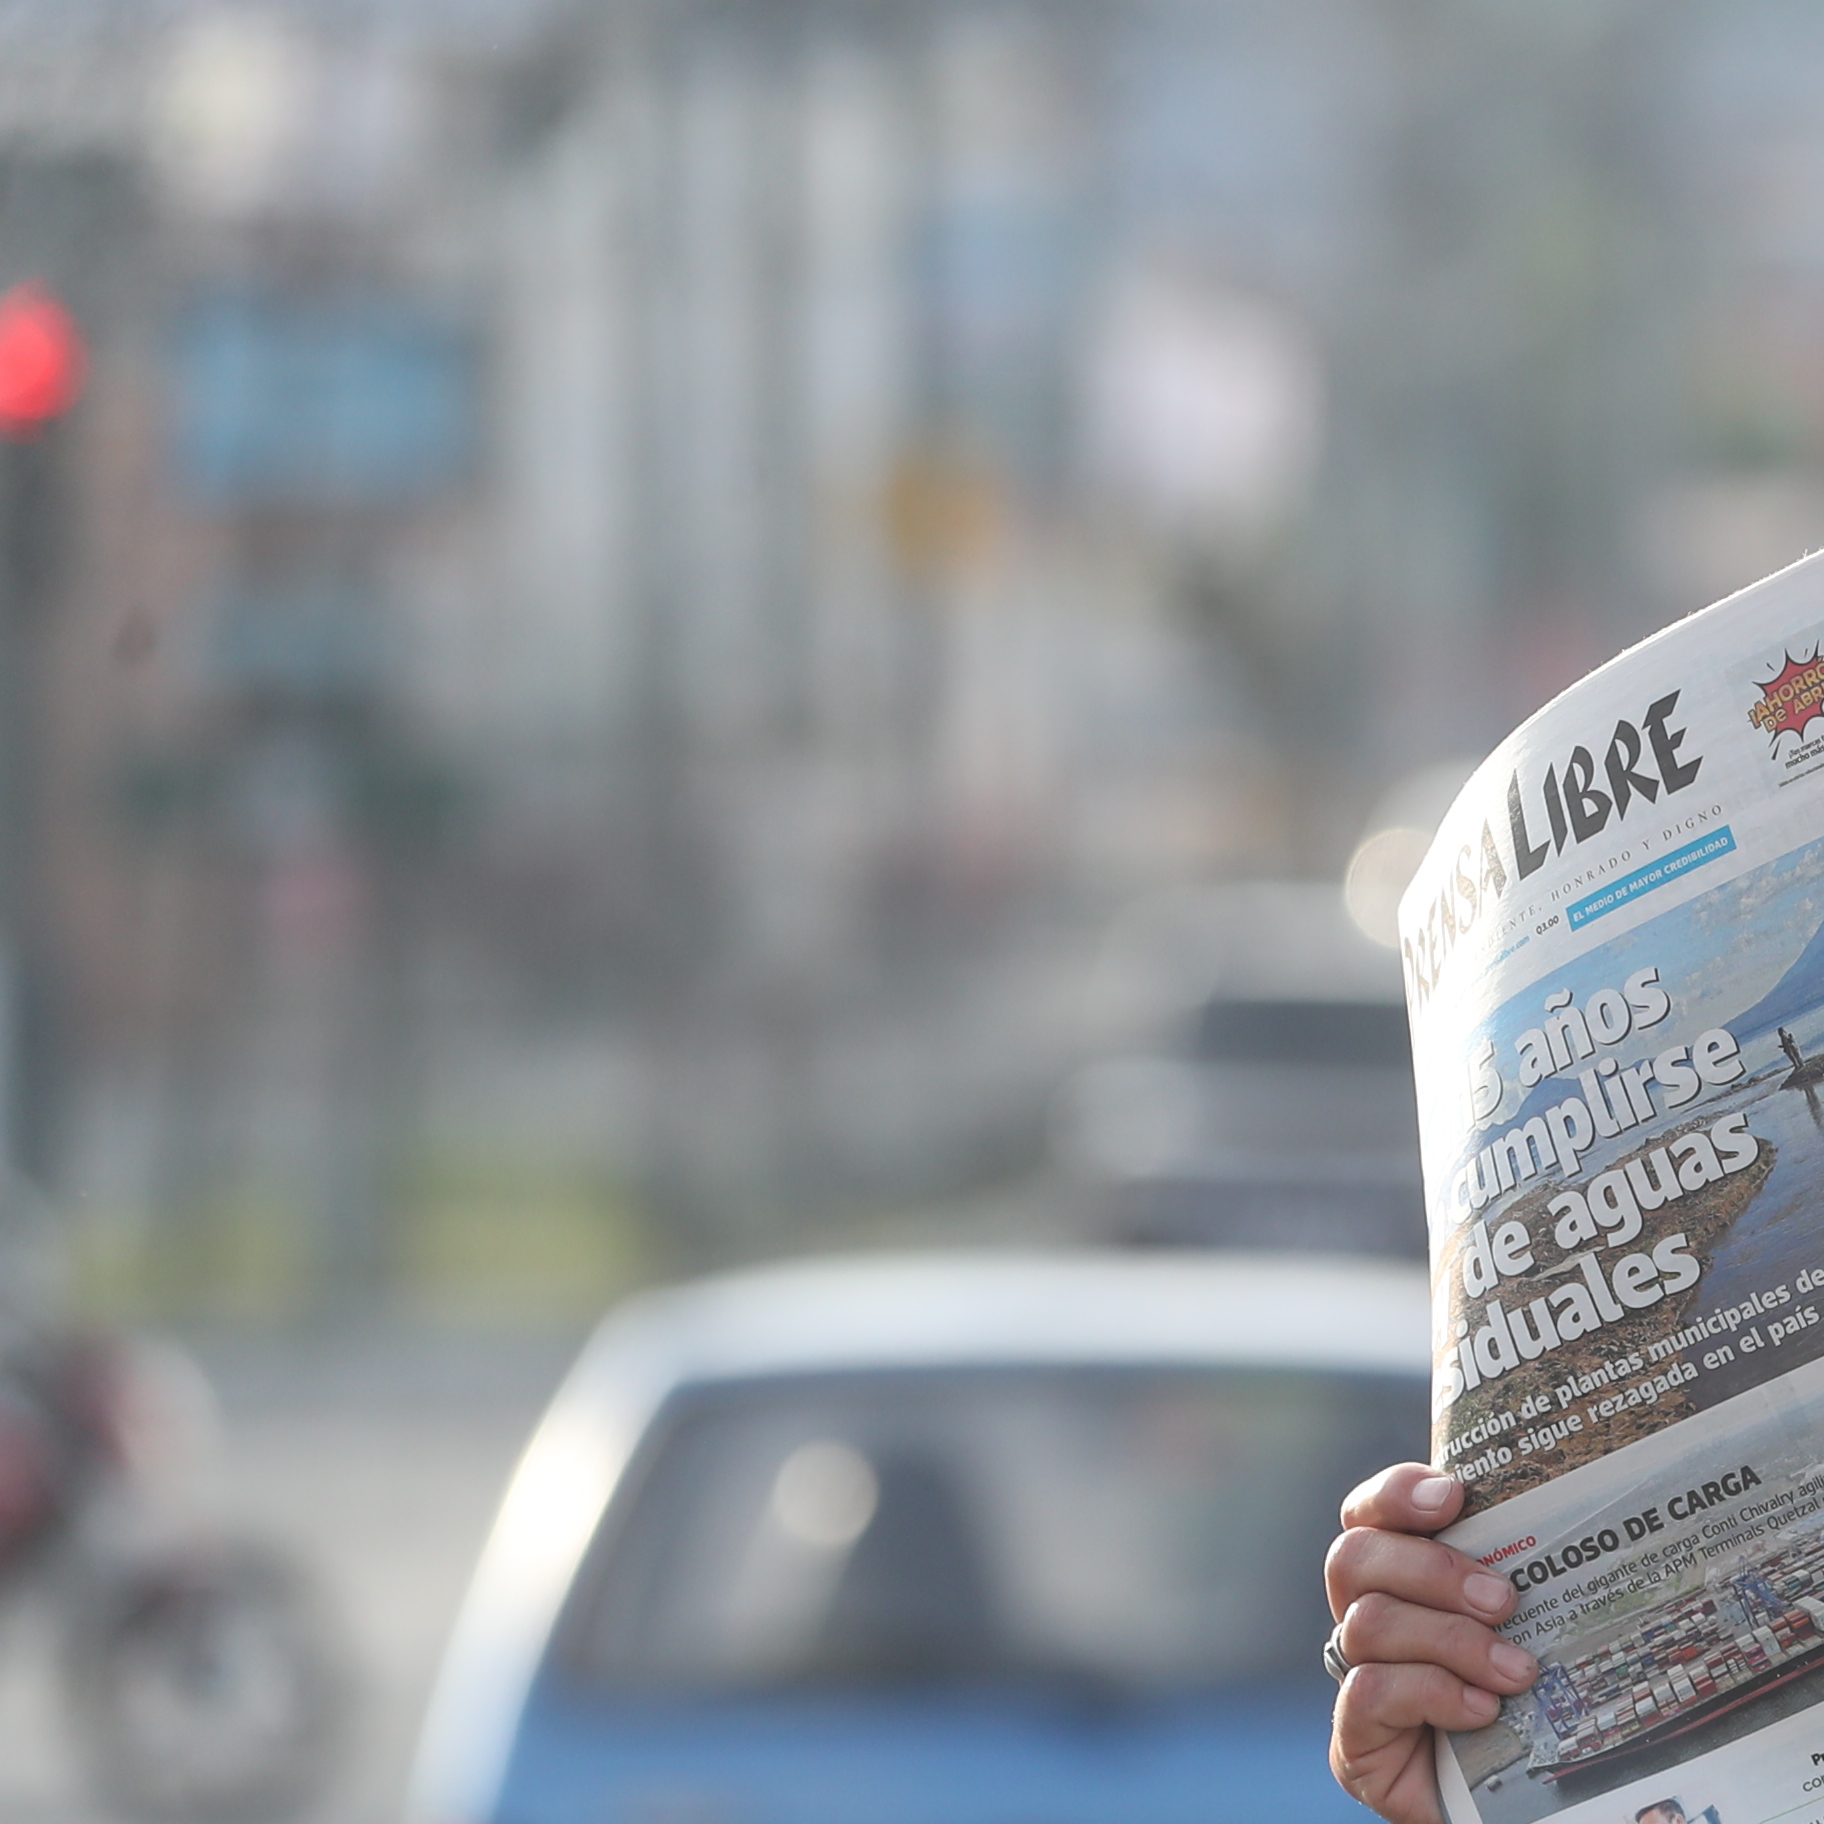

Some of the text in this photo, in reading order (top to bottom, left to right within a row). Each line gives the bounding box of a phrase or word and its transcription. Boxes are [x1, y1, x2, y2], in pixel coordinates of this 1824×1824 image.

[1503, 688, 1703, 884] LIBRE
[1515, 966, 1672, 1088] años
[1464, 1114, 1760, 1291] de aguas
[1516, 1411, 1585, 1459] sigue
[1585, 1357, 1700, 1428] rezagada
[1701, 1344, 1734, 1371] en
[1736, 1326, 1764, 1354] el
[1765, 1301, 1821, 1344] país
[1517, 1390, 1551, 1420] de
[1553, 1346, 1644, 1405] plantas
[1644, 1278, 1791, 1365] municipales
[1509, 1463, 1762, 1597] COLOSO DE CARGA
[1560, 1583, 1585, 1604] del
[1585, 1559, 1641, 1598] gigante
[1639, 1548, 1661, 1569] de
[1661, 1532, 1701, 1562] carga
[1700, 1512, 1738, 1541] Conti
[1738, 1487, 1796, 1526] Chivalry
